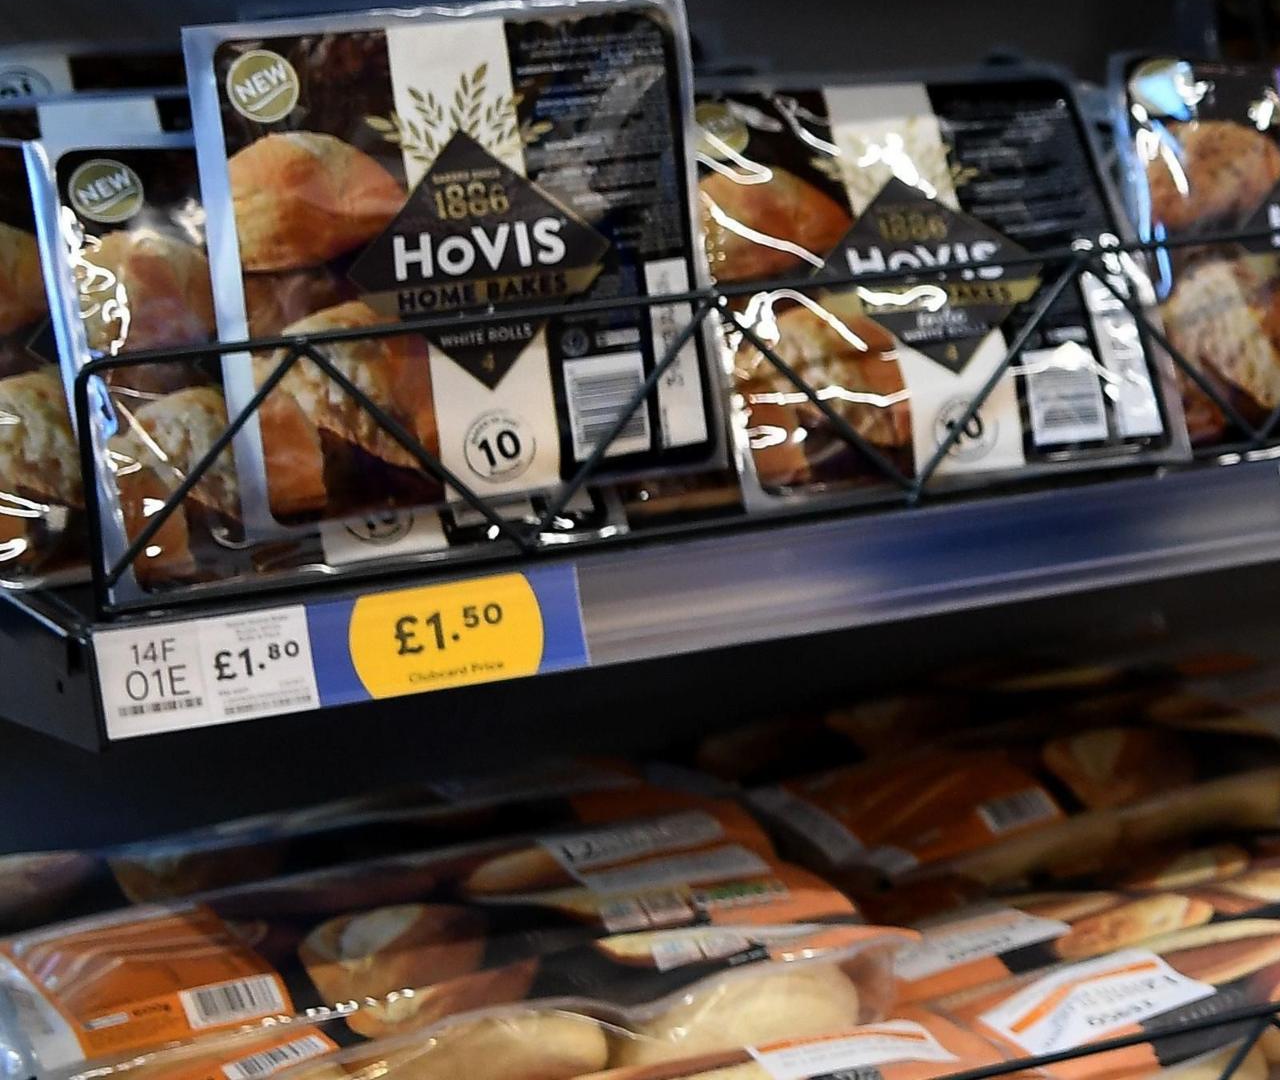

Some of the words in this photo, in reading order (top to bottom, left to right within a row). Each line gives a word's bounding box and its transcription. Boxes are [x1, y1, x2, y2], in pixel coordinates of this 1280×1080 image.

[235, 61, 287, 103] NEW
[77, 168, 132, 206] NEW
[434, 181, 509, 220] 1886
[398, 281, 475, 313] HOME
[486, 271, 567, 304] BAKES
[440, 328, 484, 347] WHITE
[487, 323, 533, 341] ROLLS
[478, 430, 521, 467] 10
[394, 603, 503, 655] £1.50
[130, 638, 176, 665] 14F
[213, 639, 300, 681] £1.80
[471, 661, 505, 676] Price
[125, 664, 191, 701] 01E
